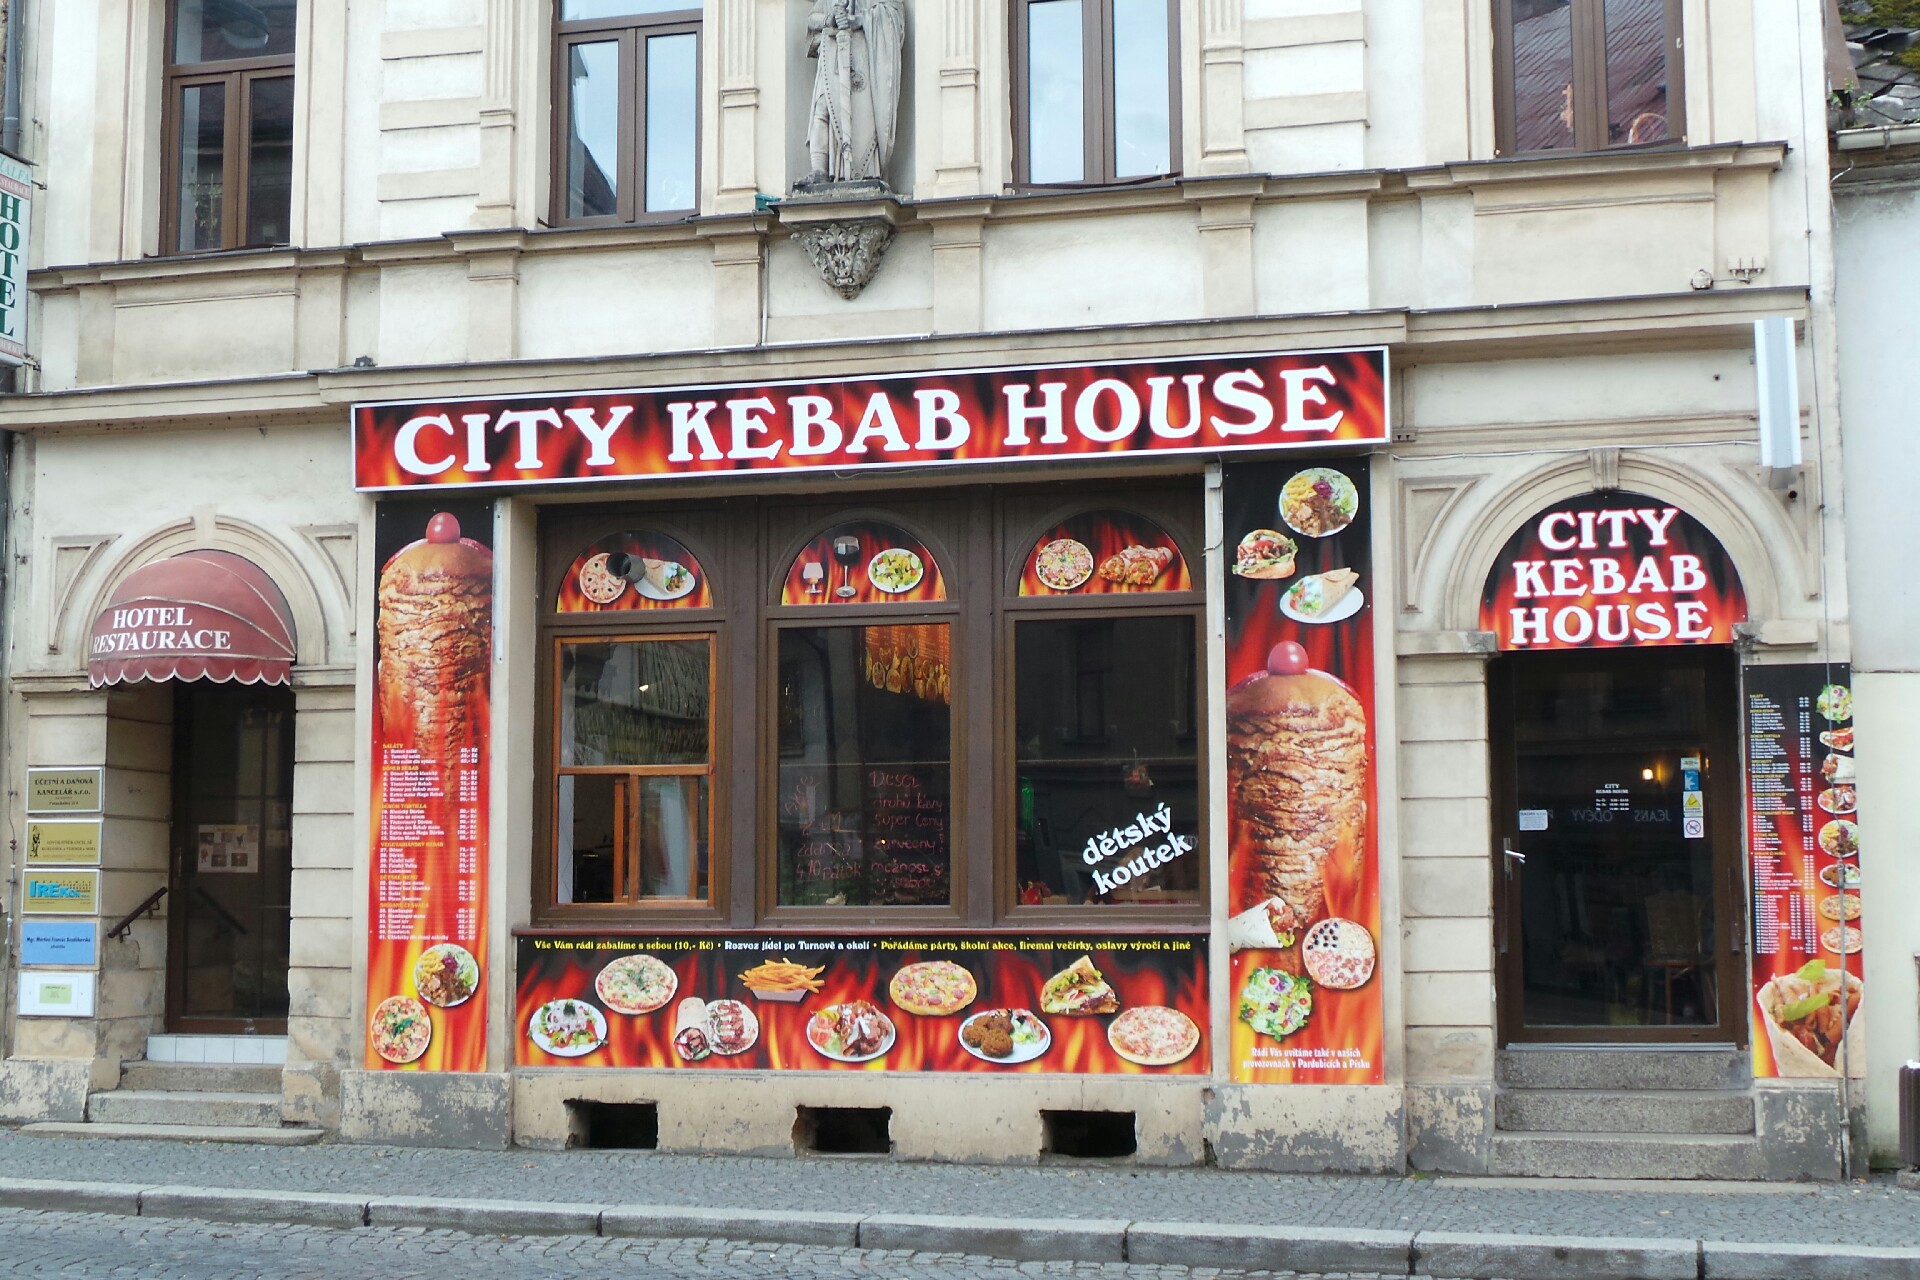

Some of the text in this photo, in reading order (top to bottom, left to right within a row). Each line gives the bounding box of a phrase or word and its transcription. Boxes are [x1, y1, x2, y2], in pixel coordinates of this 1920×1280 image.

[393, 365, 1344, 476] CITY KEBAB HOUSE
[1538, 507, 1679, 551] CITY
[1513, 554, 1707, 599] KEBAB
[112, 607, 193, 629] HOTEL
[1510, 601, 1713, 645] HOUSE
[92, 630, 231, 654] RESTAURACE
[1082, 801, 1171, 866] dětský
[1091, 832, 1193, 895] koutek
[535, 941, 551, 949] Vše
[554, 941, 573, 949] Vám
[576, 941, 593, 949] rádi
[596, 941, 636, 949] zabalíme
[646, 941, 672, 950] sebou
[699, 941, 714, 951] Kč)
[725, 941, 759, 950] Rozvoz
[761, 941, 782, 951] jídel
[798, 941, 835, 950] Turnově
[846, 941, 869, 950] okolí
[881, 941, 928, 950] Pořádáme
[930, 941, 958, 951] párty,
[961, 941, 989, 950] školní
[992, 941, 1017, 951] akce,
[1020, 941, 1053, 950] firemní
[1056, 941, 1093, 951] večírky,
[1096, 941, 1128, 951] oslavy
[1130, 941, 1161, 951] výročí
[1172, 941, 1191, 951] jiné
[1252, 1047, 1268, 1057] Rádi
[1270, 1047, 1282, 1057] Vás
[1284, 1047, 1313, 1057] uvítáme
[1314, 1047, 1330, 1057] také
[1337, 1047, 1361, 1057] našich
[1297, 1058, 1341, 1069] Pardubicích
[1349, 1059, 1370, 1068] Písku
